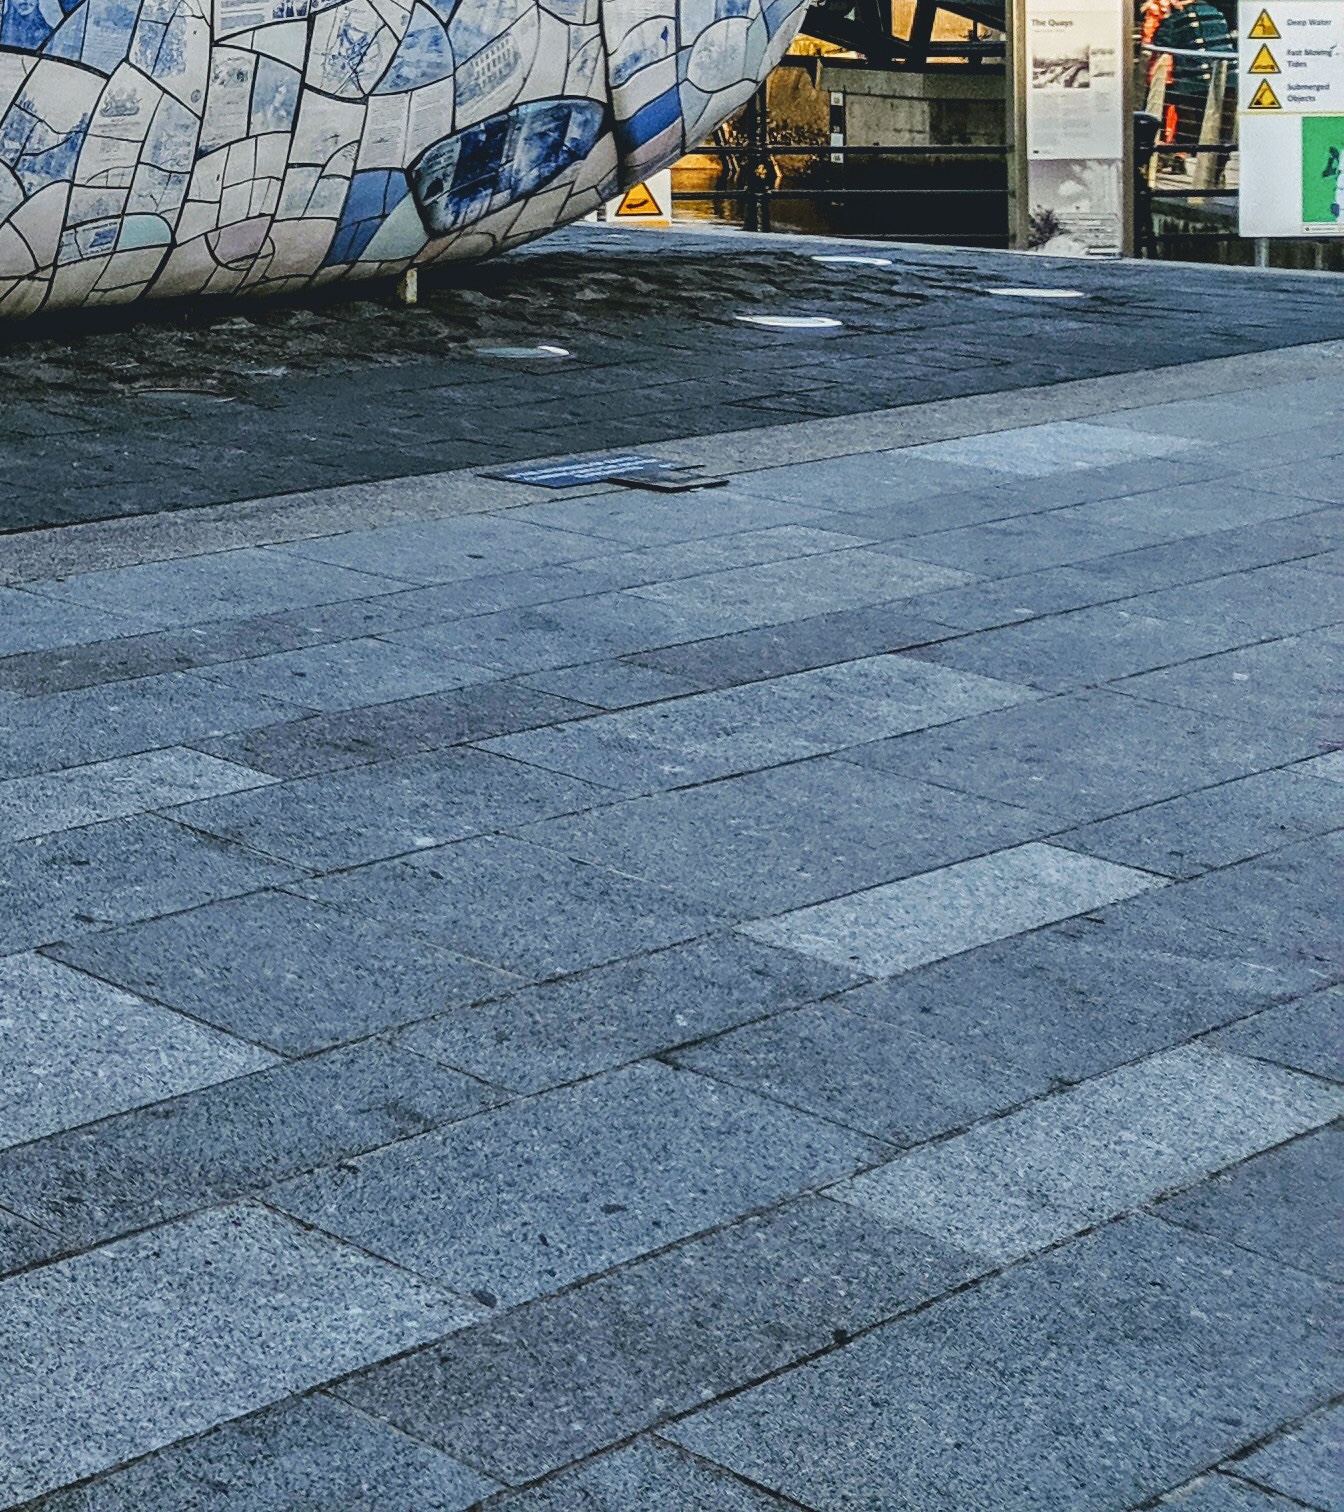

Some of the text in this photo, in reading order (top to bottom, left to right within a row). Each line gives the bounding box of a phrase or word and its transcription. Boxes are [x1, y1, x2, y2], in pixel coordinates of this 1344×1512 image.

[1287, 19, 1307, 27] Deep
[1304, 49, 1332, 57] Moving
[1287, 60, 1307, 68] Tides
[1287, 83, 1330, 92] Submerged
[1287, 95, 1316, 103] Objects
